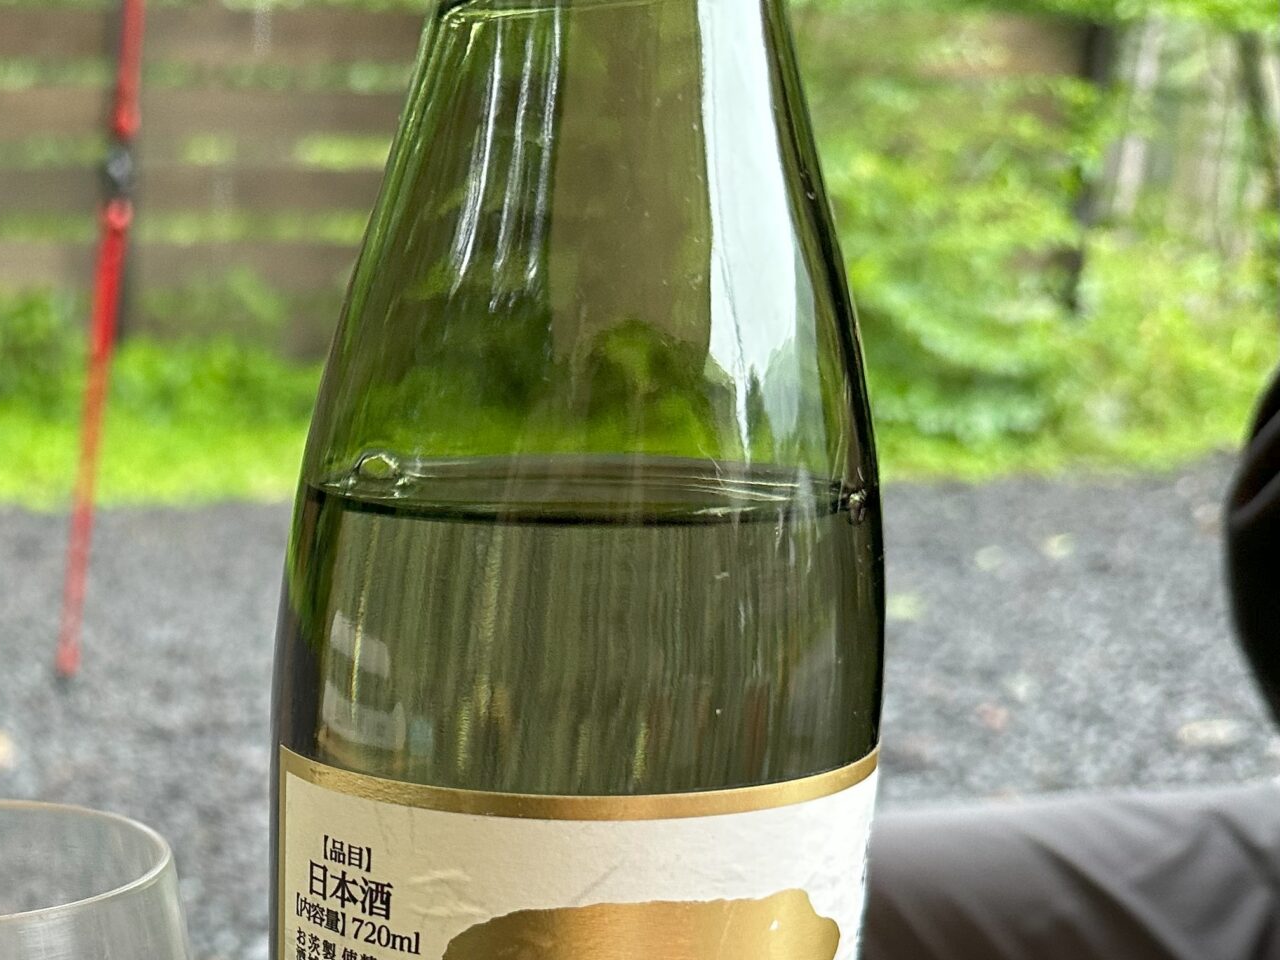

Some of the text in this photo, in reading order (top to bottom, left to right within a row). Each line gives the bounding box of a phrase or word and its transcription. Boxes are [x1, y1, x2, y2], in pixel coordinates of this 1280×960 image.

[323, 834, 372, 873] 【品目】
[309, 859, 394, 920] 日本酒
[296, 891, 421, 955] 【内容量】 720ml
